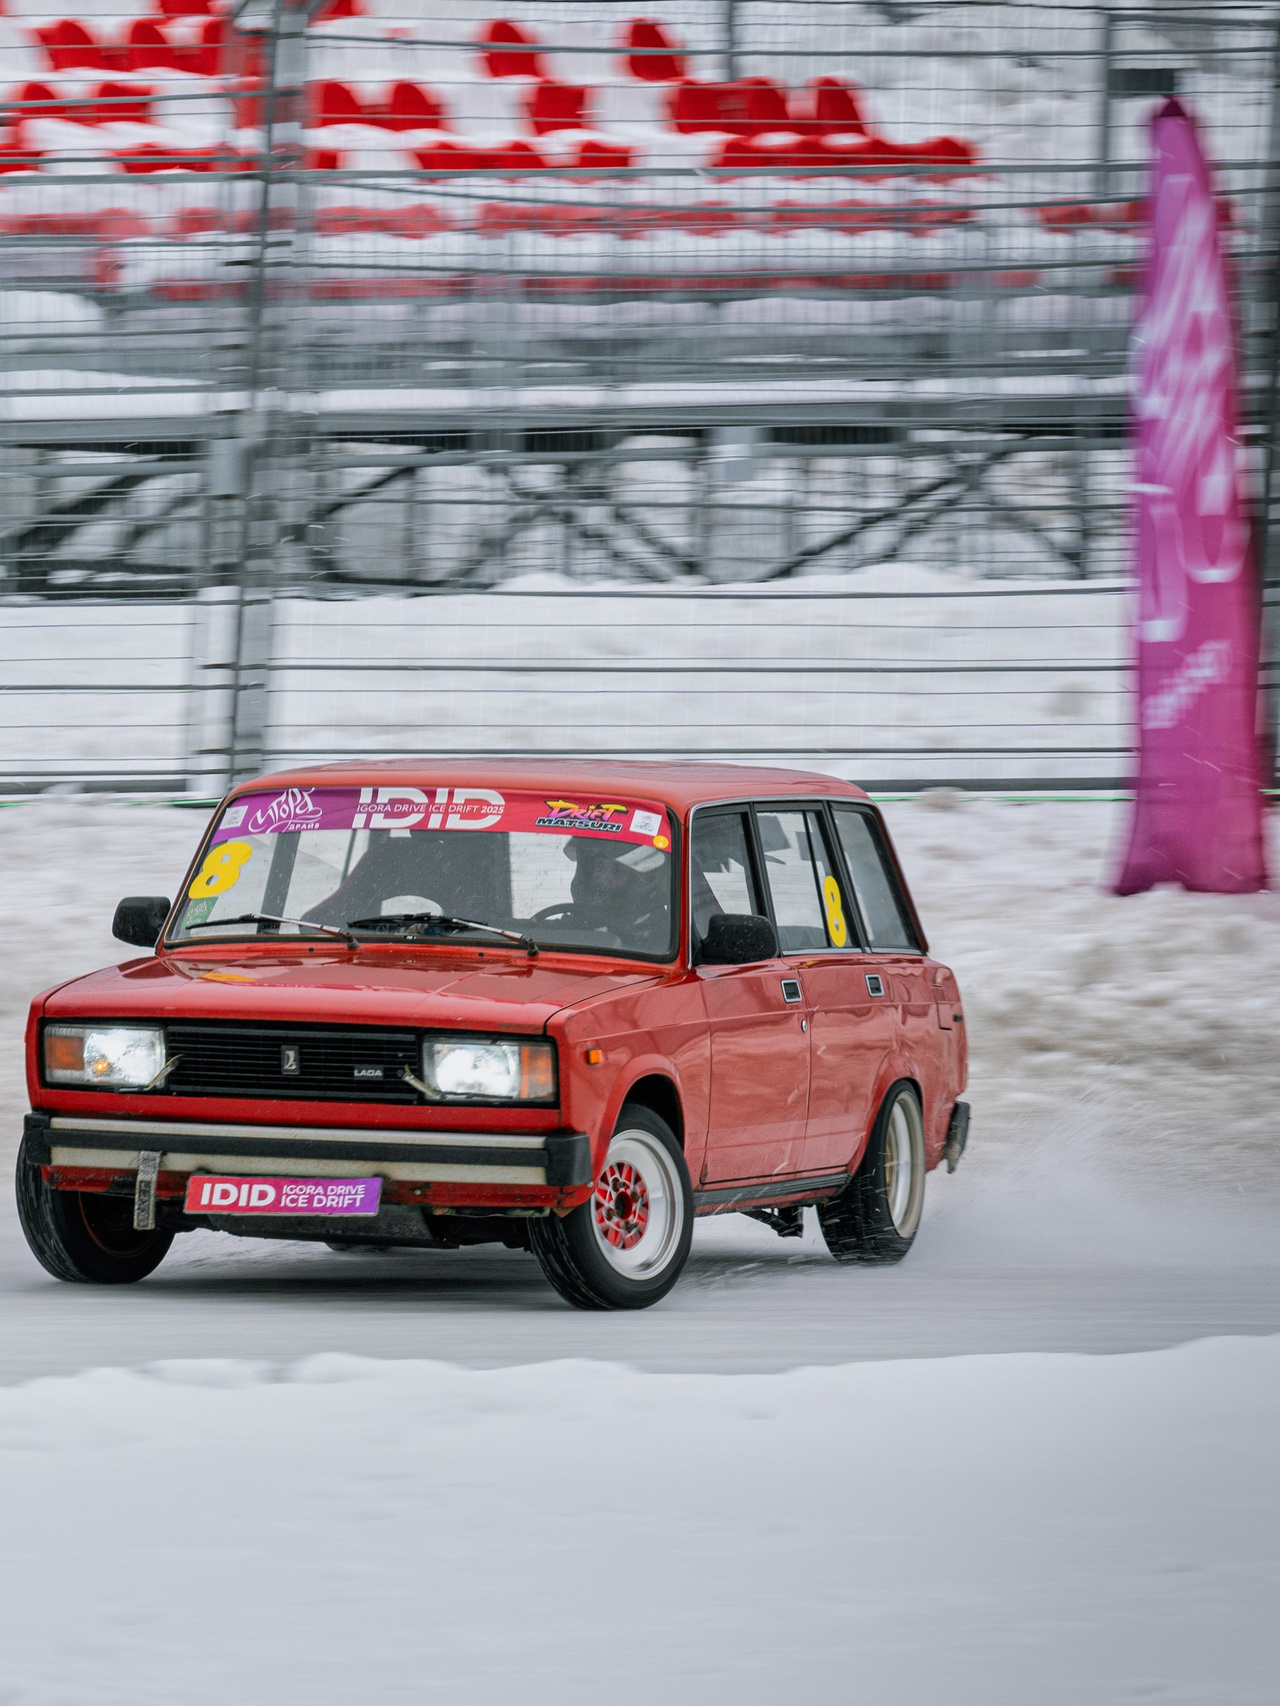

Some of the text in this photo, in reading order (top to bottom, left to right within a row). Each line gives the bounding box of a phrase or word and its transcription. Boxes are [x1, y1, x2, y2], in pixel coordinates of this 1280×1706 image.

[351, 787, 505, 829] IDID
[357, 804, 505, 814] IGORA DRIVE ICE DRIFT 2025
[535, 816, 623, 832] MATSURI
[188, 841, 253, 899] 8
[823, 875, 847, 947] 8
[354, 1069, 383, 1077] LADA
[200, 1183, 276, 1207] IDID
[283, 1184, 366, 1195] IGORA DRIVE
[280, 1195, 365, 1208] ICE DRIFT
